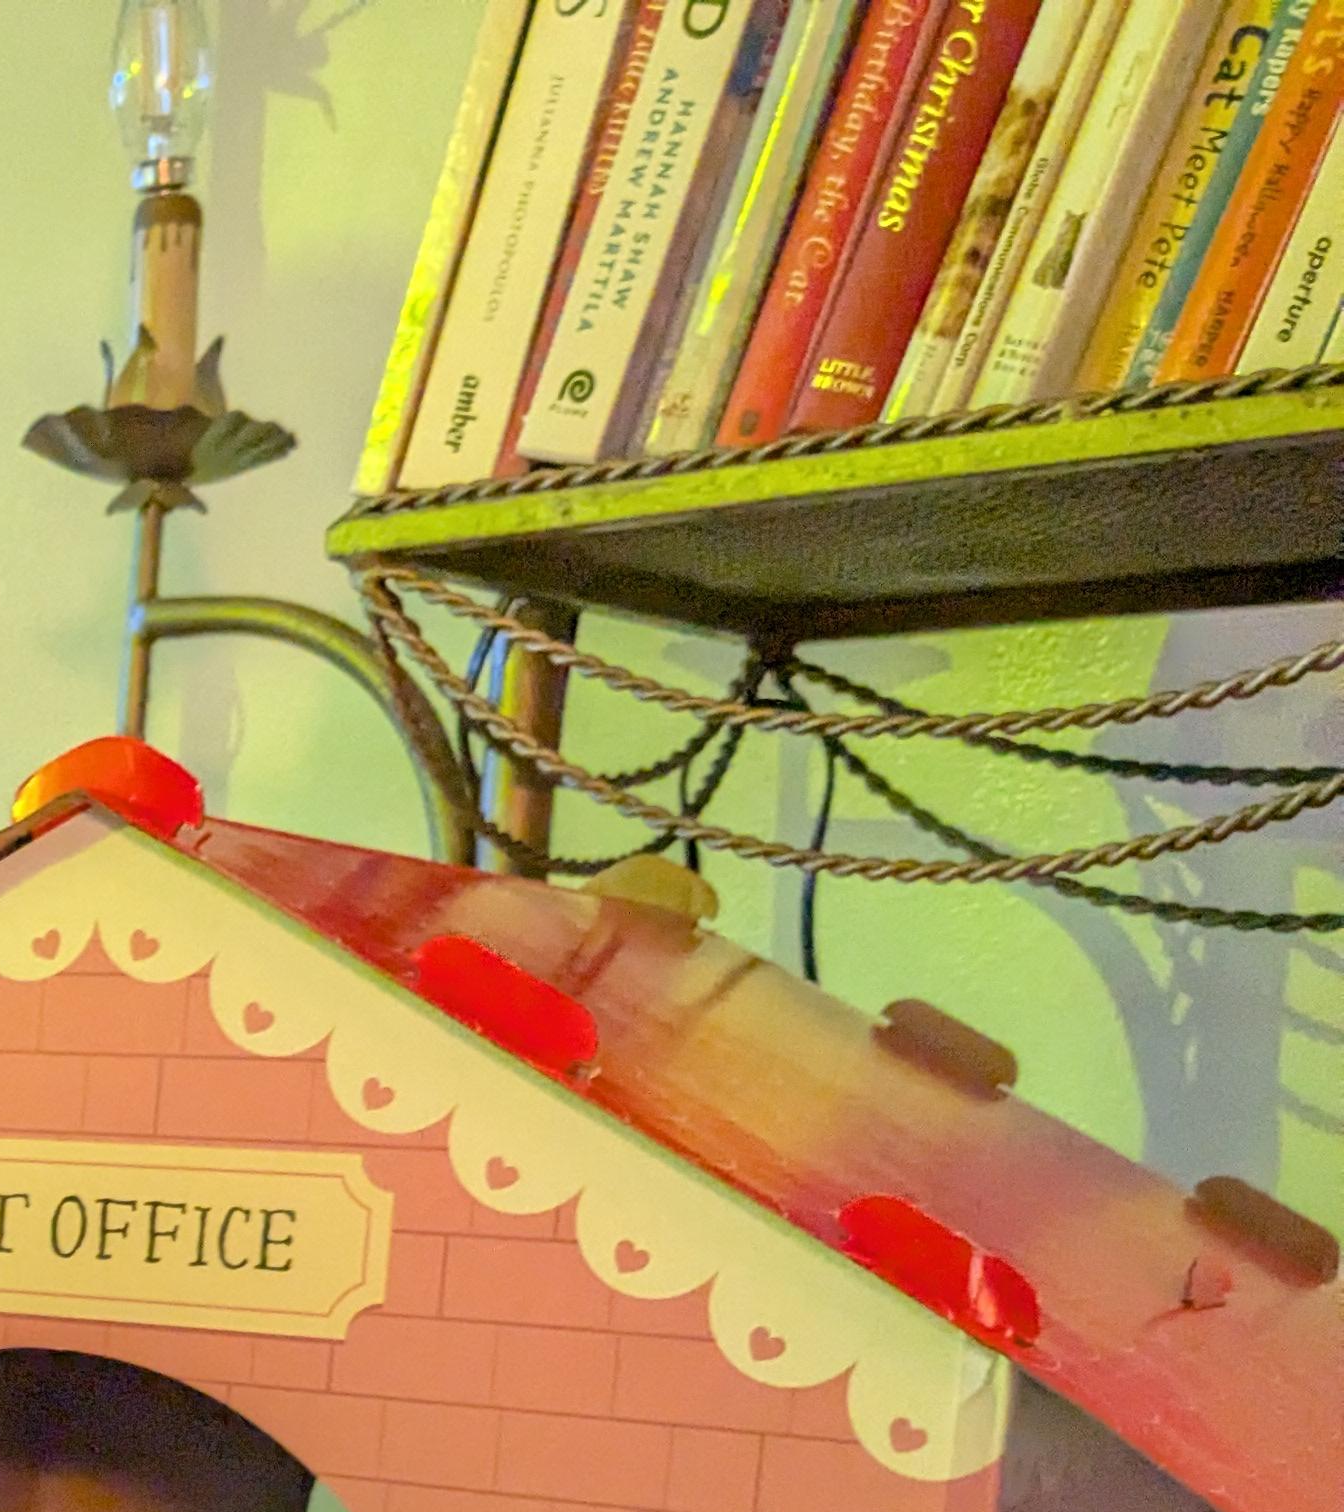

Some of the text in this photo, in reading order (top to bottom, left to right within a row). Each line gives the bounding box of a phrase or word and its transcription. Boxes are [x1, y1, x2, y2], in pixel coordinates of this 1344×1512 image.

[1204, 25, 1270, 108] Cat
[1249, 28, 1305, 116] Kapers
[627, 67, 680, 187] ANDREW
[876, 31, 980, 233] Christmas
[1278, 88, 1322, 154] Happy
[612, 100, 696, 310] HANNAH SHAW
[811, 176, 849, 225] the
[1171, 127, 1229, 208] Meet
[784, 233, 834, 303] Cat
[1136, 222, 1192, 289] Pete
[1277, 236, 1333, 343] aperture
[444, 374, 481, 454] amber
[49, 1194, 297, 1273] OFFICE
